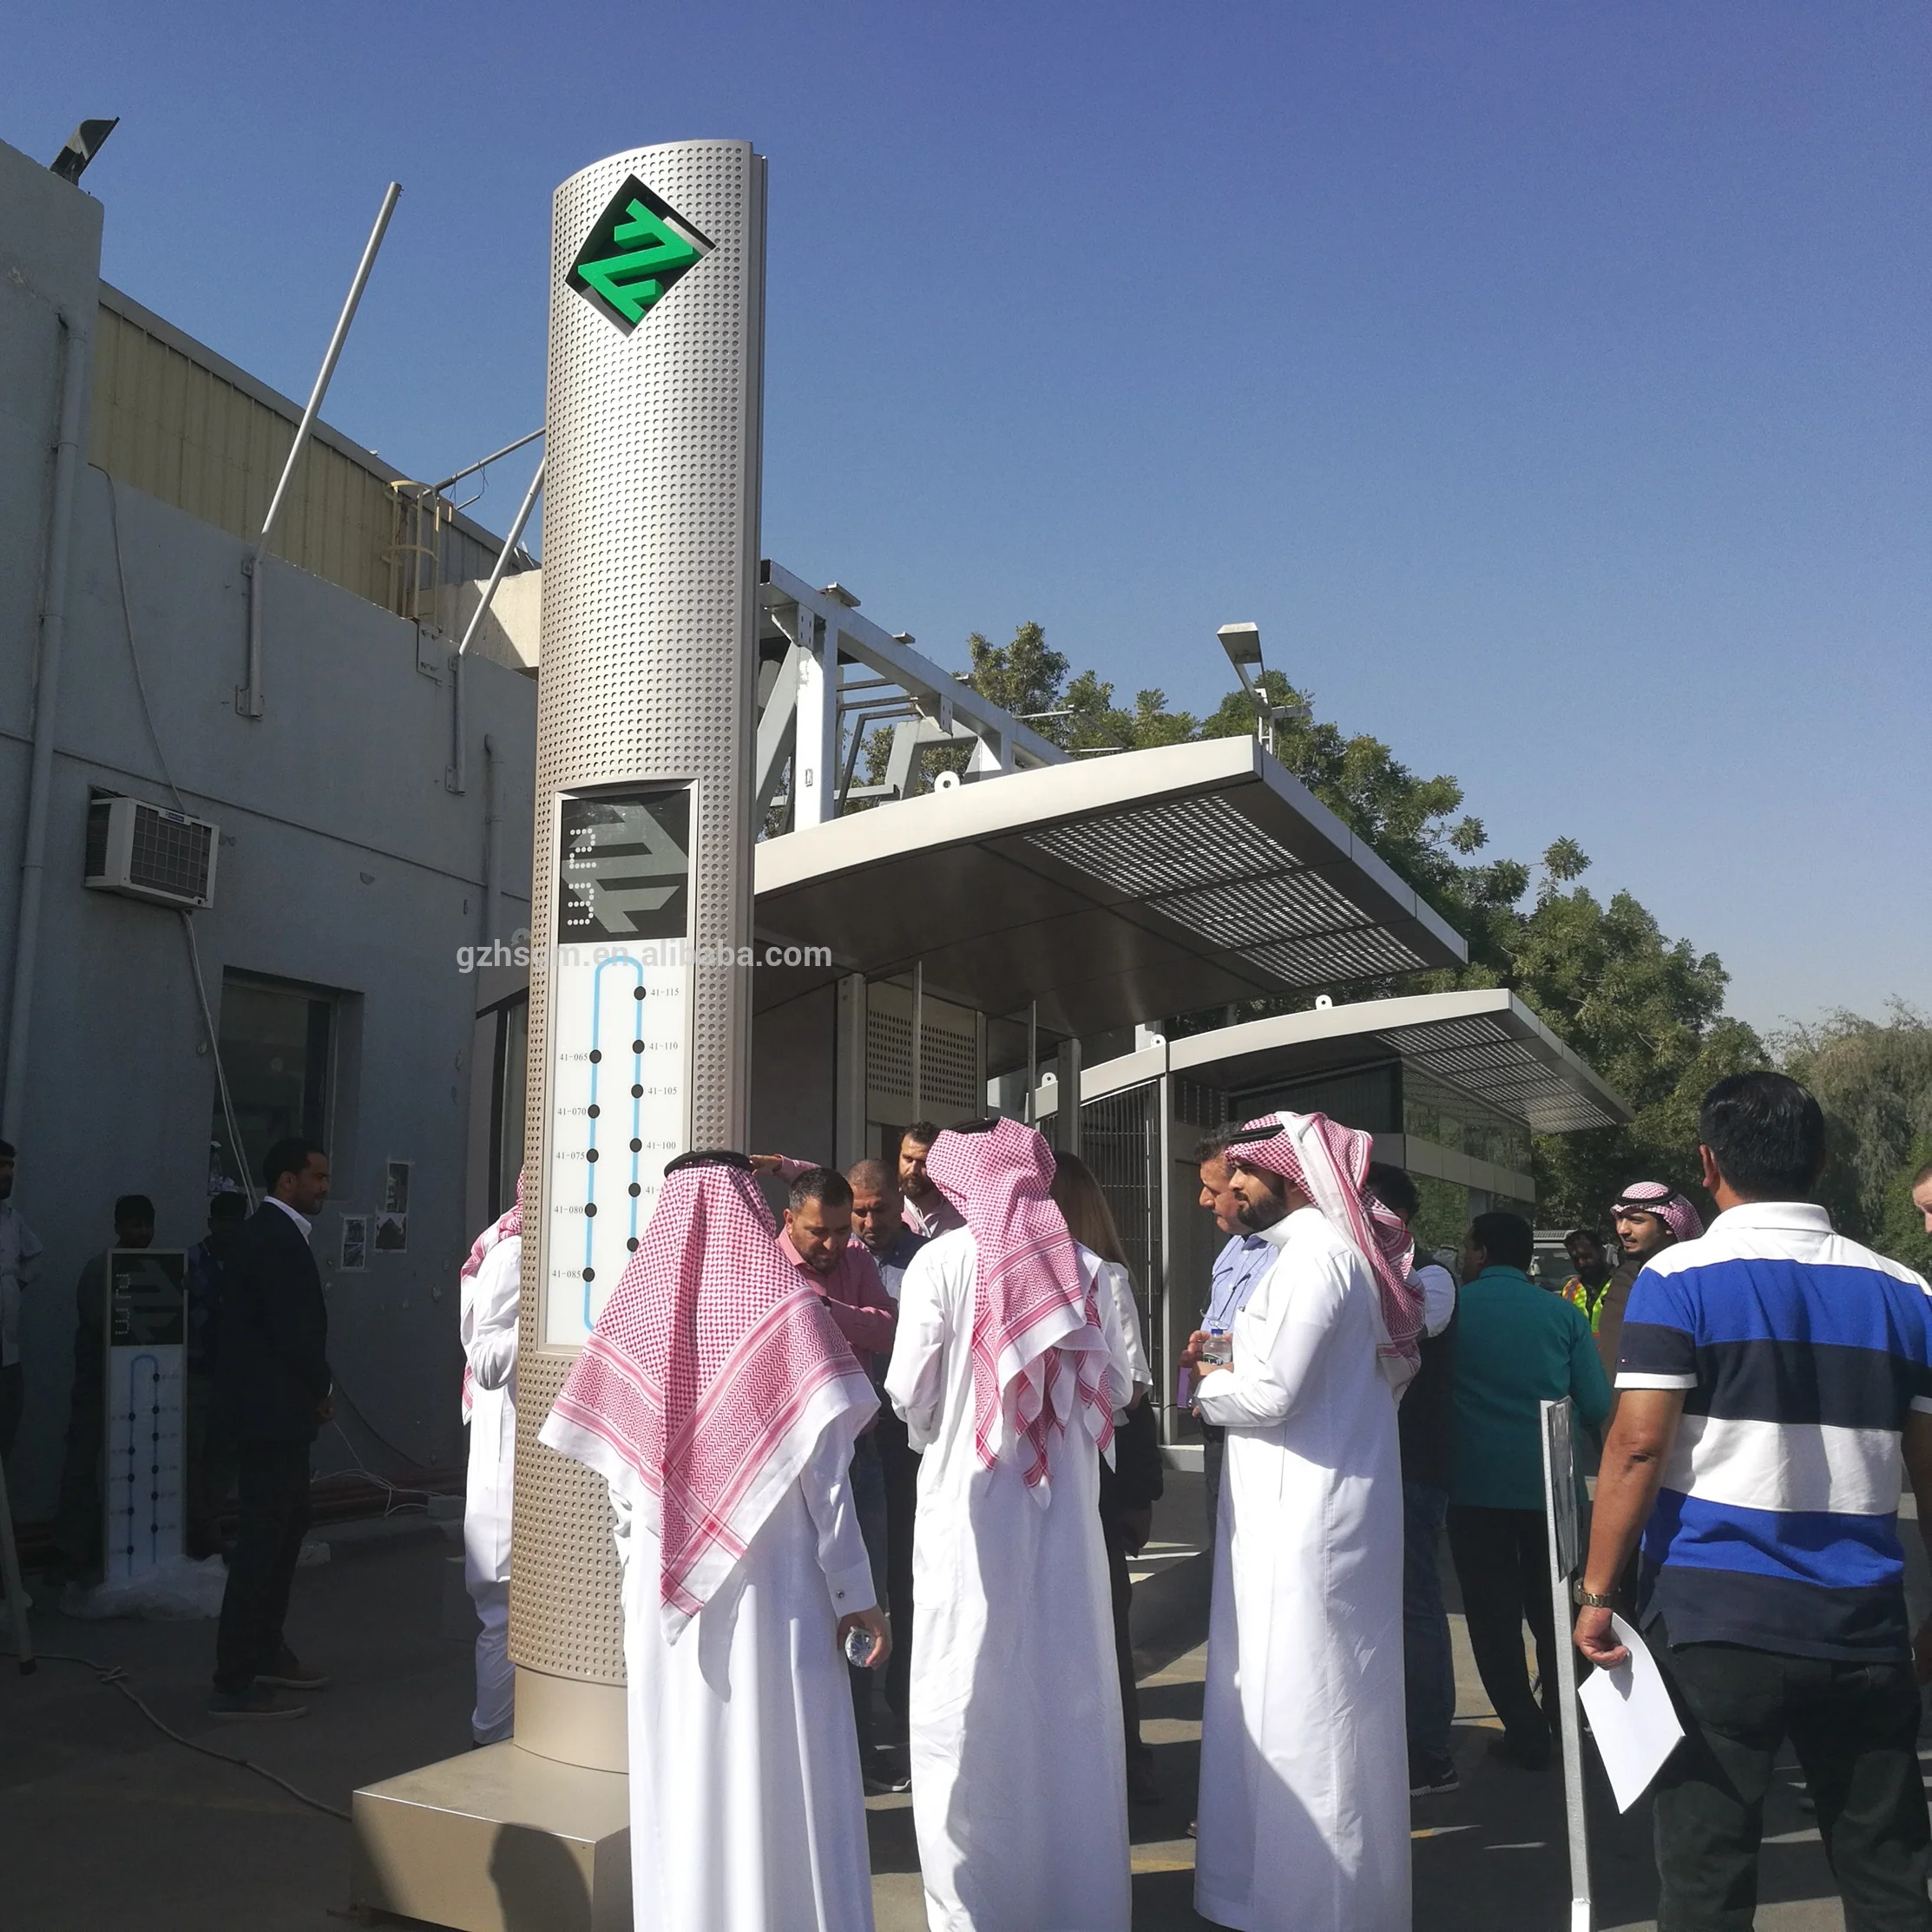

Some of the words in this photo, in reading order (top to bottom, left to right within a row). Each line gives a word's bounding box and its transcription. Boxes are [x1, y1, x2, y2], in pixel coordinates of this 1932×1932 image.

[650, 986, 680, 996] 41-115
[648, 1042, 678, 1050] 41-110
[559, 1053, 588, 1061] 41-065
[647, 1087, 677, 1095] 41-105
[557, 1107, 587, 1116] 41-070
[646, 1141, 676, 1150] 41-100
[555, 1152, 585, 1160] 41-075
[554, 1206, 583, 1214] 41-080
[552, 1270, 582, 1278] 41-085
